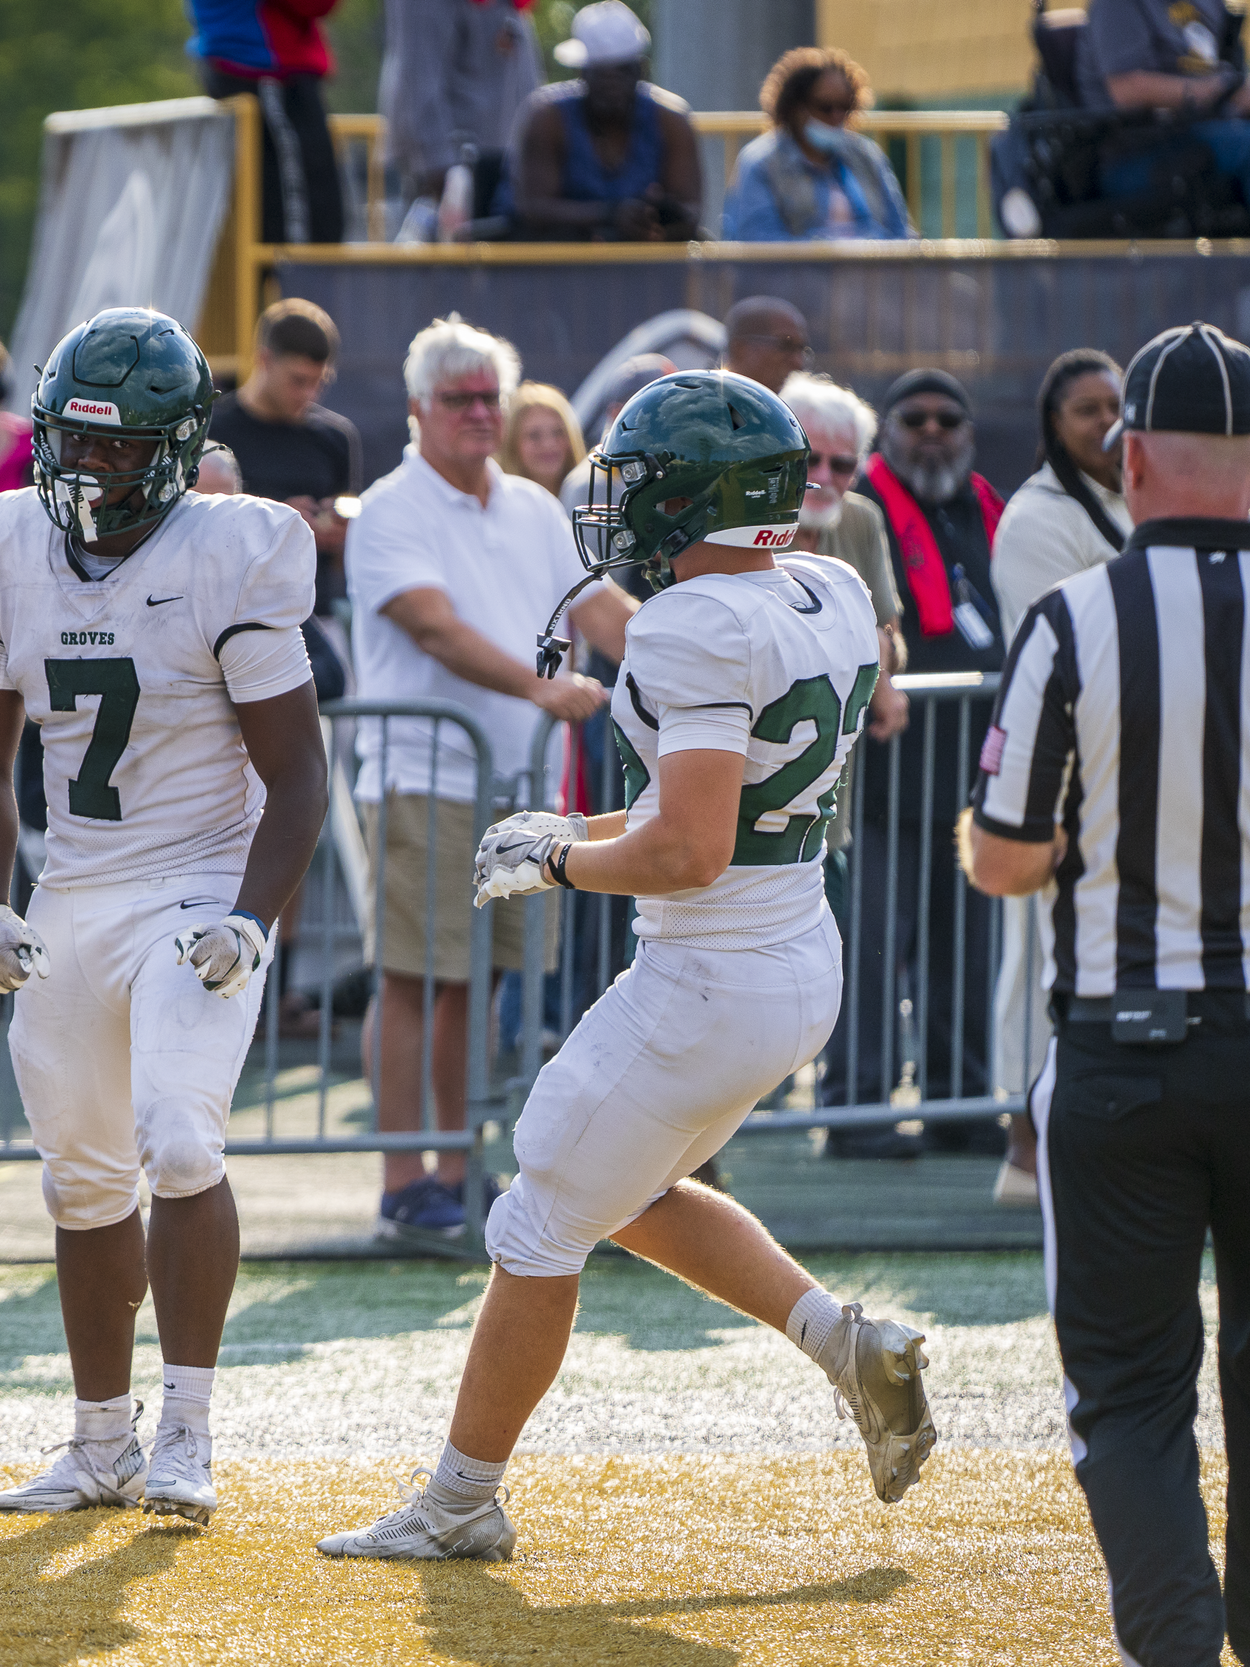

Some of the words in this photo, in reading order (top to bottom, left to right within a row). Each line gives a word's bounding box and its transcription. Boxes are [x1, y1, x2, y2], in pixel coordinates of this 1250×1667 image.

[70, 401, 112, 415] Riddell
[60, 631, 115, 645] GROVES
[44, 656, 141, 821] 7
